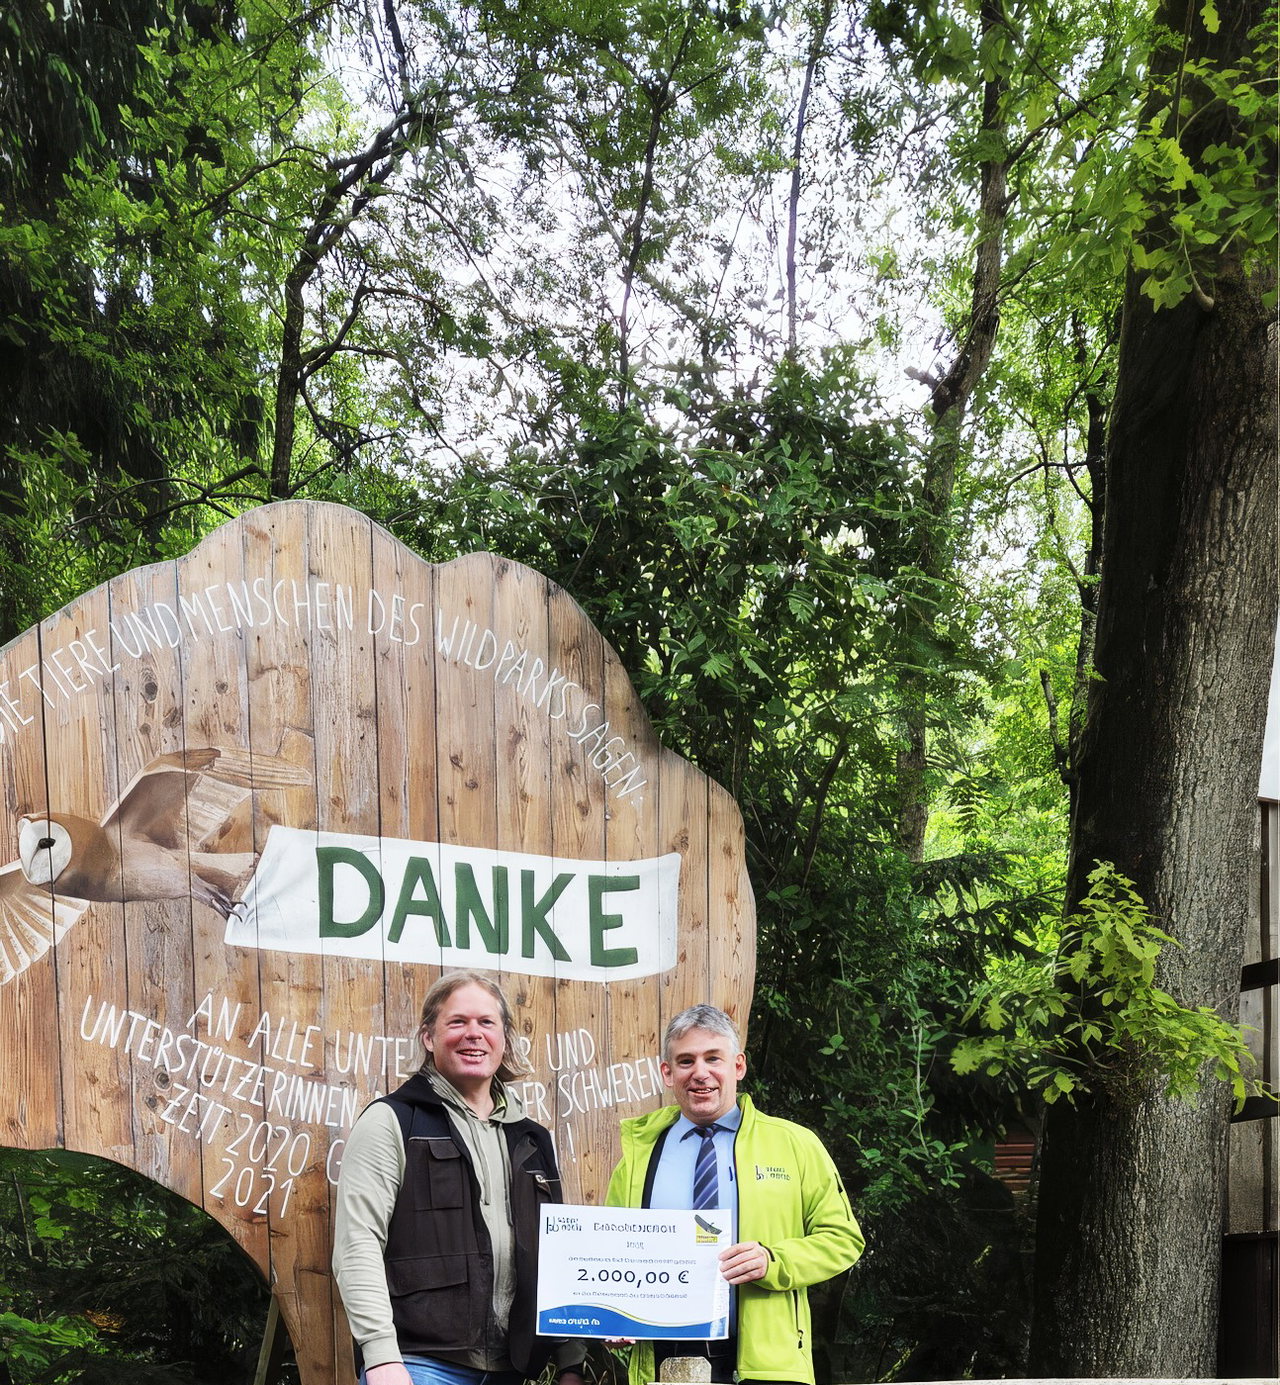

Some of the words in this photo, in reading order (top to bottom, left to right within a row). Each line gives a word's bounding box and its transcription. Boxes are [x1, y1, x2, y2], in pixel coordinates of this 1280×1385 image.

[0, 681, 34, 744] IE
[19, 628, 121, 709] TIERE
[368, 588, 424, 646] DES
[438, 608, 579, 719] WILDPARKS
[315, 846, 641, 967] DANKE
[80, 994, 358, 1128] UNTERSTÜTZERINNEN
[558, 1055, 664, 1118] SCHWEREN
[186, 992, 241, 1042] AN
[248, 1011, 321, 1068] ALLE
[546, 1028, 595, 1071] UND
[160, 1082, 232, 1145] ZEIT
[225, 1113, 310, 1177] 2020
[209, 1158, 293, 1218] 2021
[577, 1268, 670, 1289] 2.000,00
[678, 1270, 690, 1284] €
